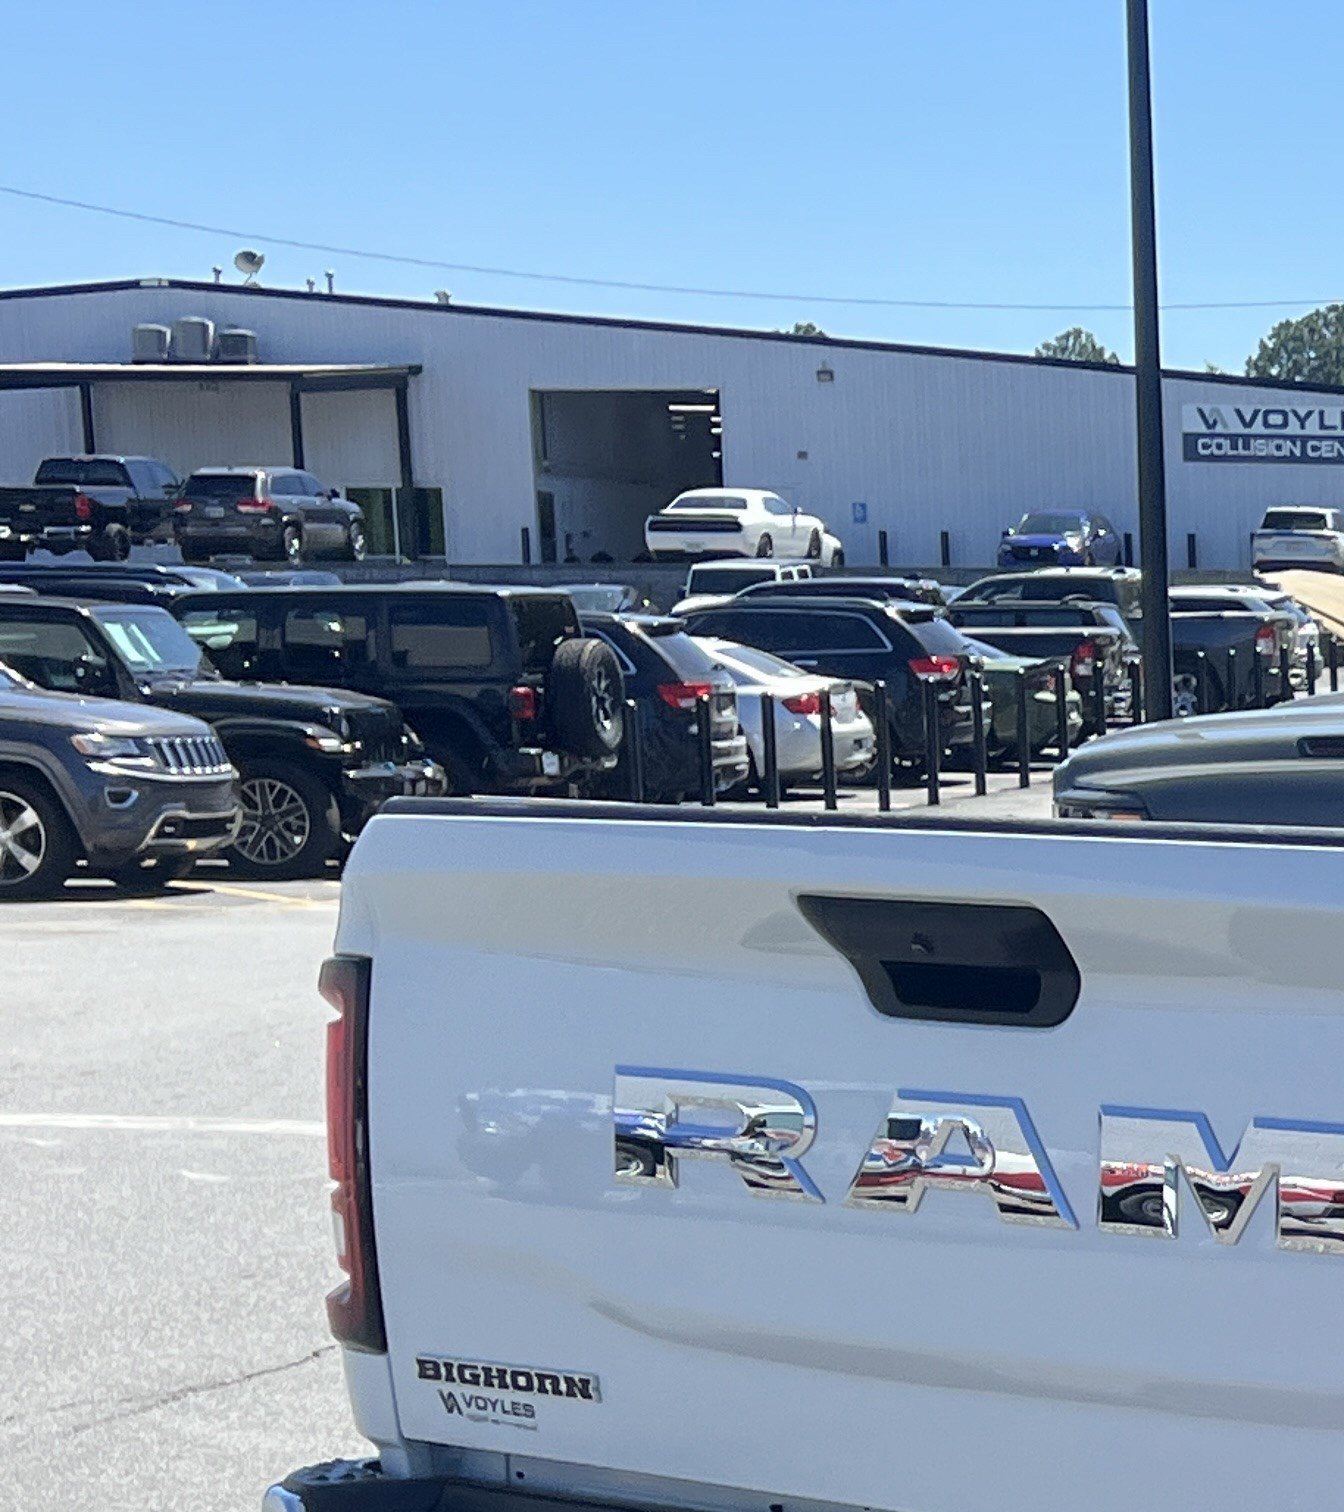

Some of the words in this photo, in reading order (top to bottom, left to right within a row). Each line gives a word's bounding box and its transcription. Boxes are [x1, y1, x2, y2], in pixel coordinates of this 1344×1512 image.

[1197, 438, 1301, 457] COLLISION
[416, 1355, 600, 1401] BIGHORN
[460, 1391, 536, 1419] VOYLES
